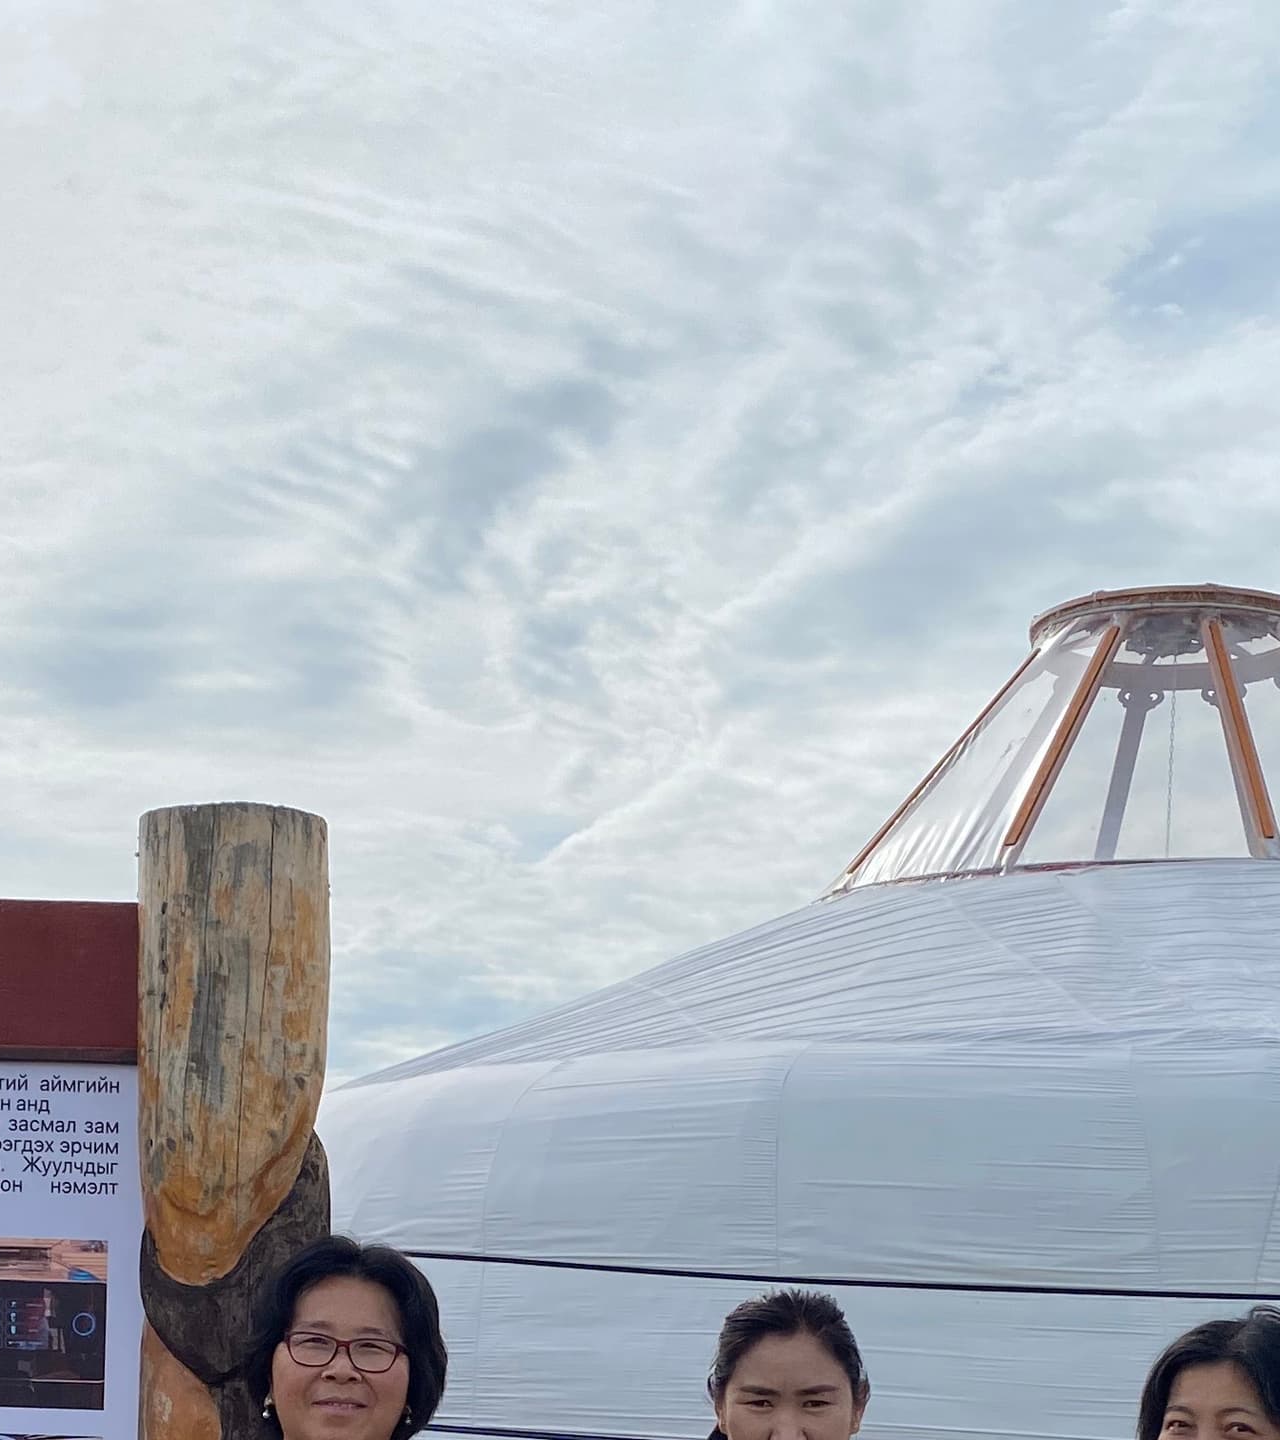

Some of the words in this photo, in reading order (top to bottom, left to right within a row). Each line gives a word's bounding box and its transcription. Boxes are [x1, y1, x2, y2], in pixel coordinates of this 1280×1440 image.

[40, 1075, 120, 1094] аймгийн
[16, 1098, 50, 1115] анд
[8, 1118, 76, 1133] засмал
[84, 1121, 119, 1134] зам
[59, 1140, 119, 1157] эрчим
[22, 1155, 119, 1178] Жуулчдыг
[51, 1181, 119, 1195] нэмэлт
